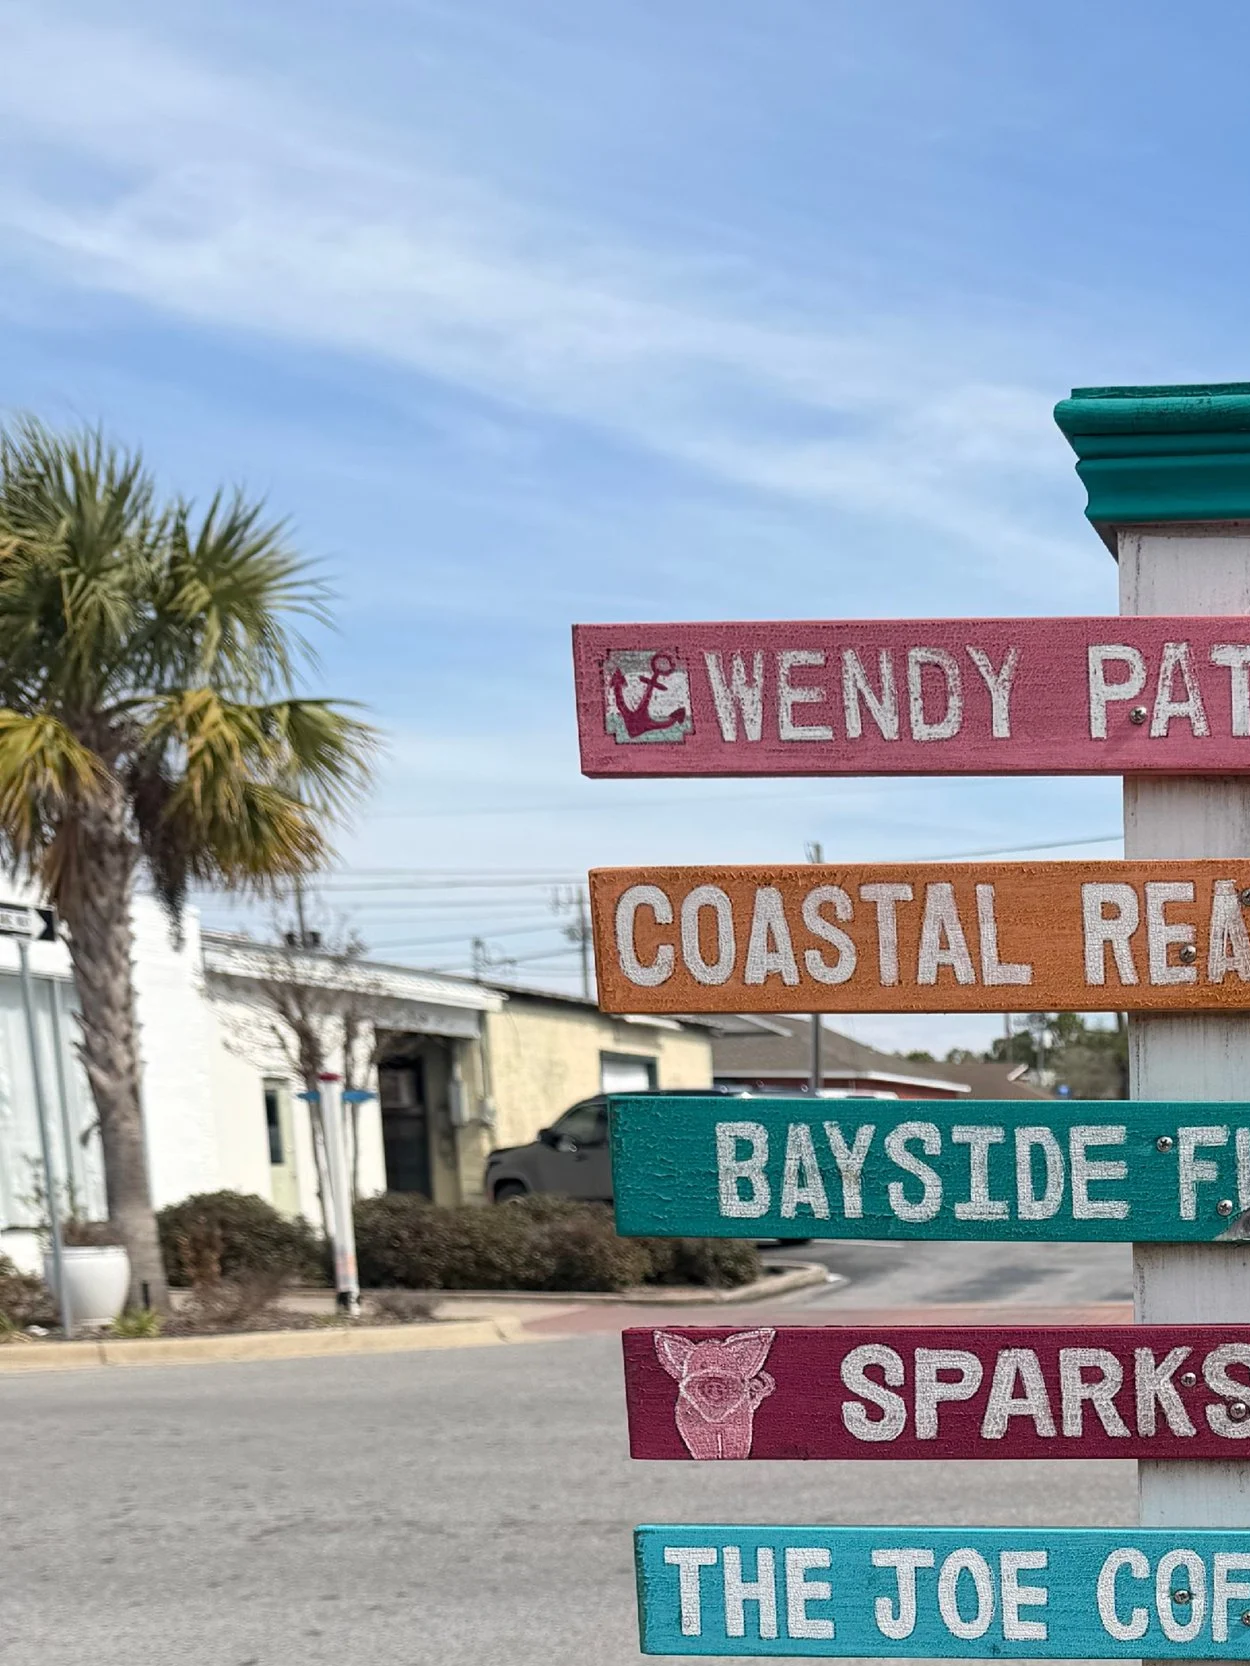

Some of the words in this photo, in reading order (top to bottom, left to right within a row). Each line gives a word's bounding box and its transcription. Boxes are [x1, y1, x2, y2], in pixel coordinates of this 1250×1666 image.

[704, 645, 1021, 743] WENDY
[615, 882, 1032, 987] COASTAL
[715, 1121, 1130, 1223] BAYSIDE
[663, 1546, 835, 1639] THE
[871, 1548, 1049, 1640] JOE
